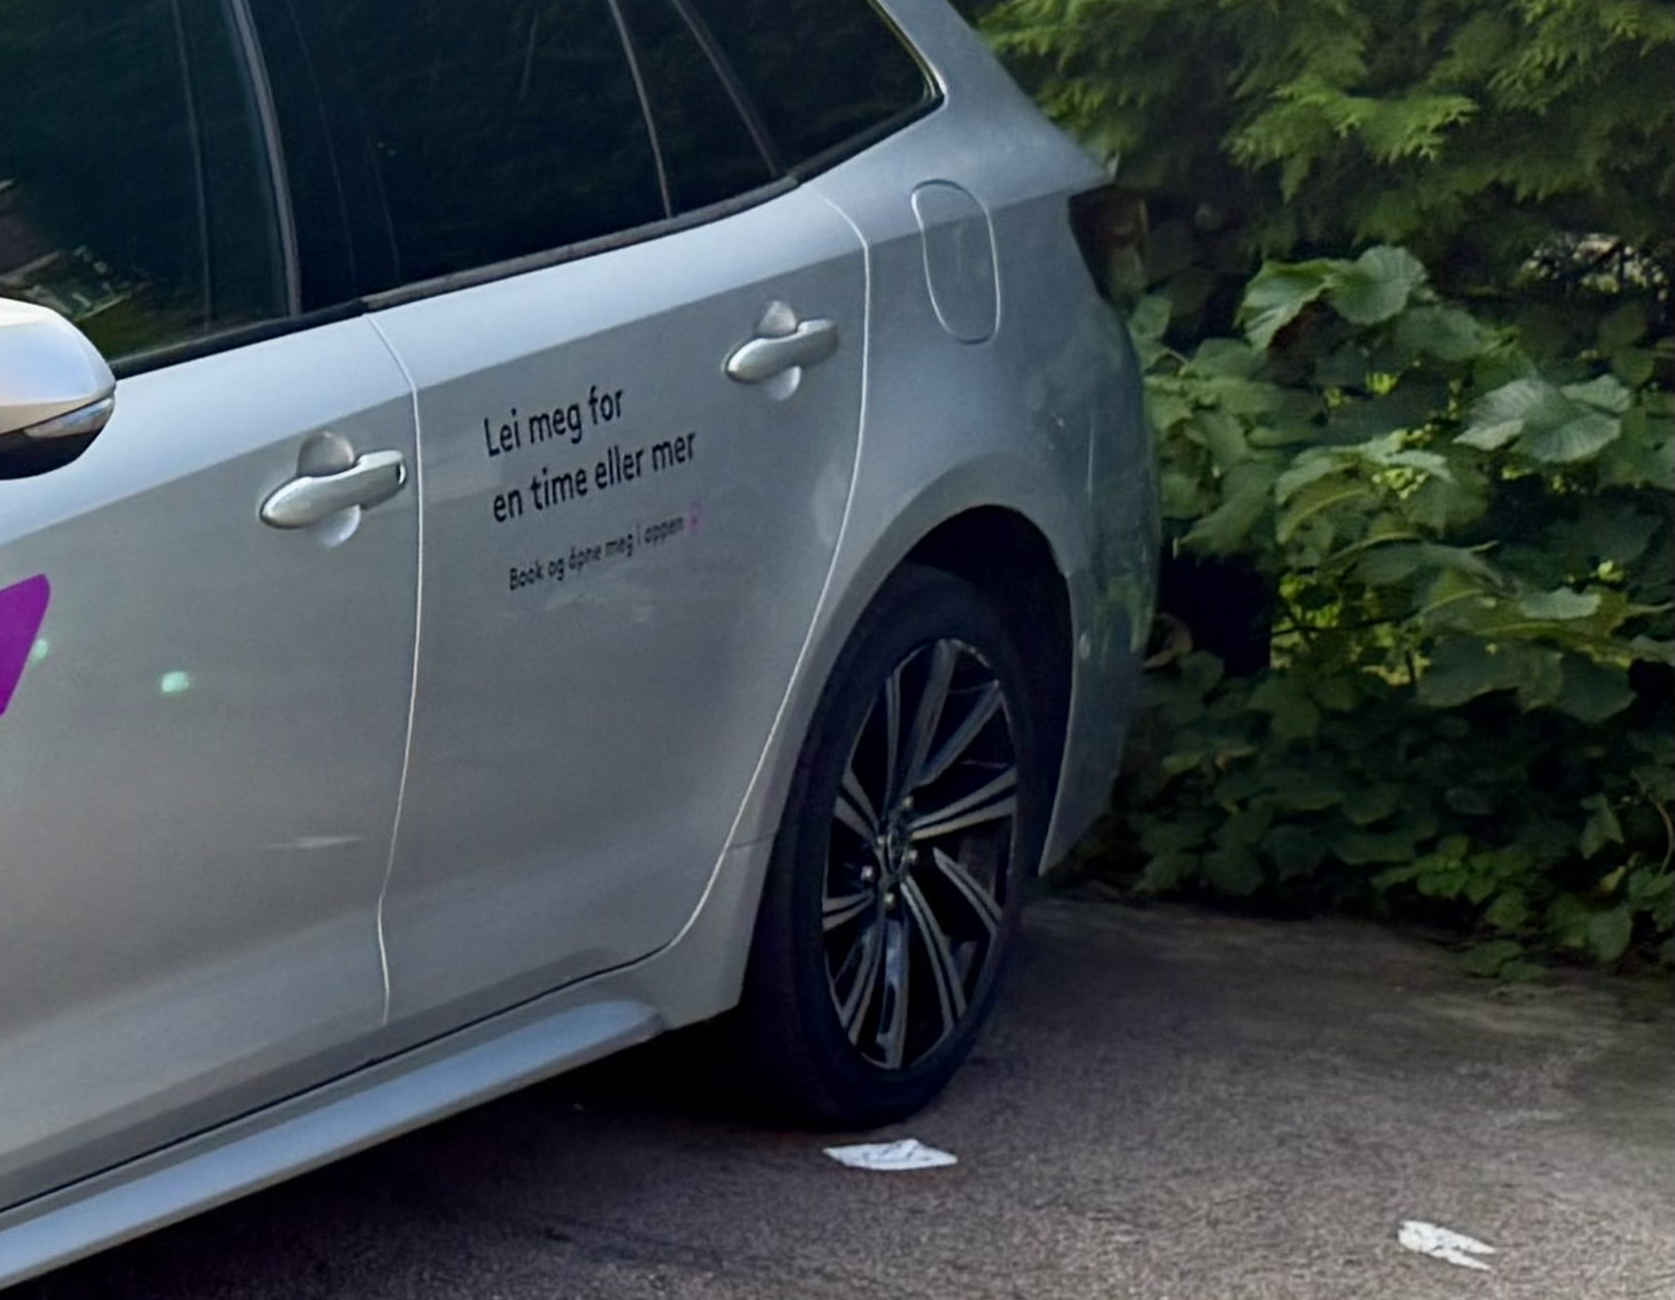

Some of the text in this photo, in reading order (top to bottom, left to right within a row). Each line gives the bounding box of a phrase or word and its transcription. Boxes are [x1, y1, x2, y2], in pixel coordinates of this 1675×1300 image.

[483, 385, 624, 457] Lei meg for
[493, 432, 696, 523] en time eller mer
[509, 561, 543, 591] Book
[548, 558, 565, 582] og
[605, 534, 634, 558] meg
